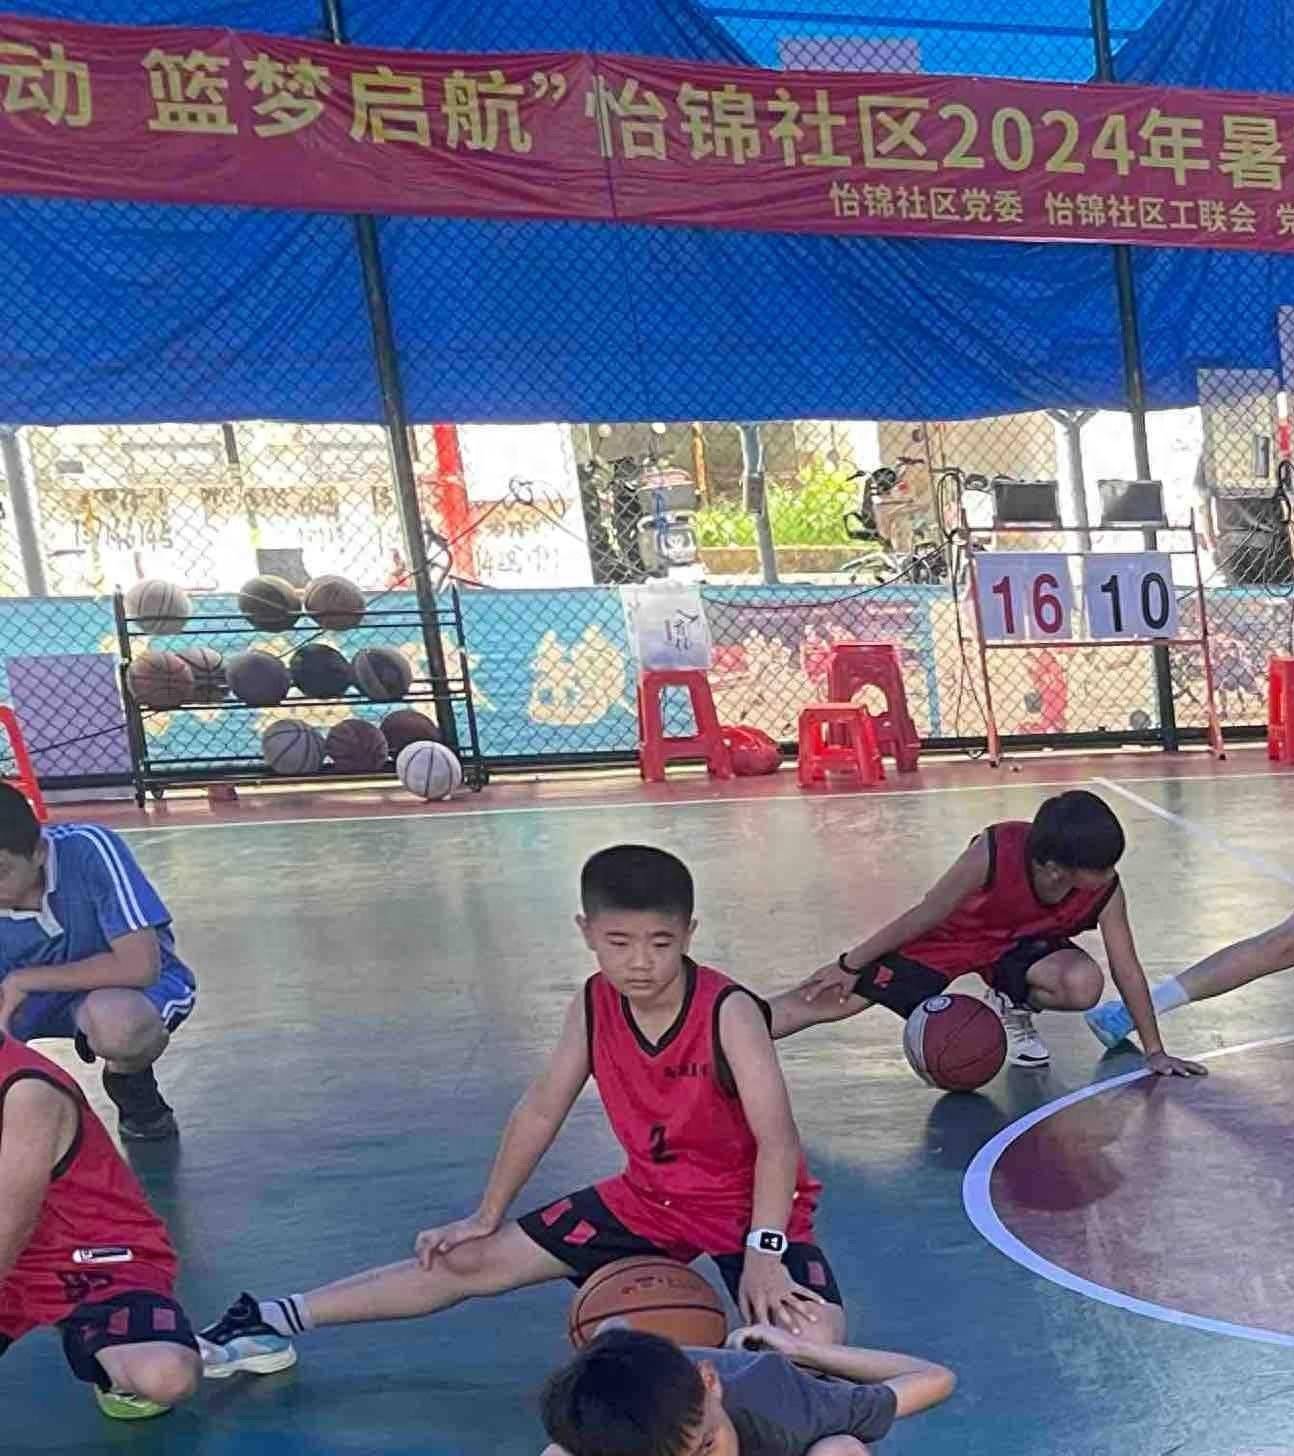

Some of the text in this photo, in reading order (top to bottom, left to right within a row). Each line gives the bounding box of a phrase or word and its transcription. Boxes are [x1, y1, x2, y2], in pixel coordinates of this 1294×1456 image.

[0, 42, 92, 127] 动
[829, 181, 1024, 224] 怡锦社区党委
[1044, 191, 1257, 234] 怡锦社区工联会
[992, 571, 1171, 635] 16 10
